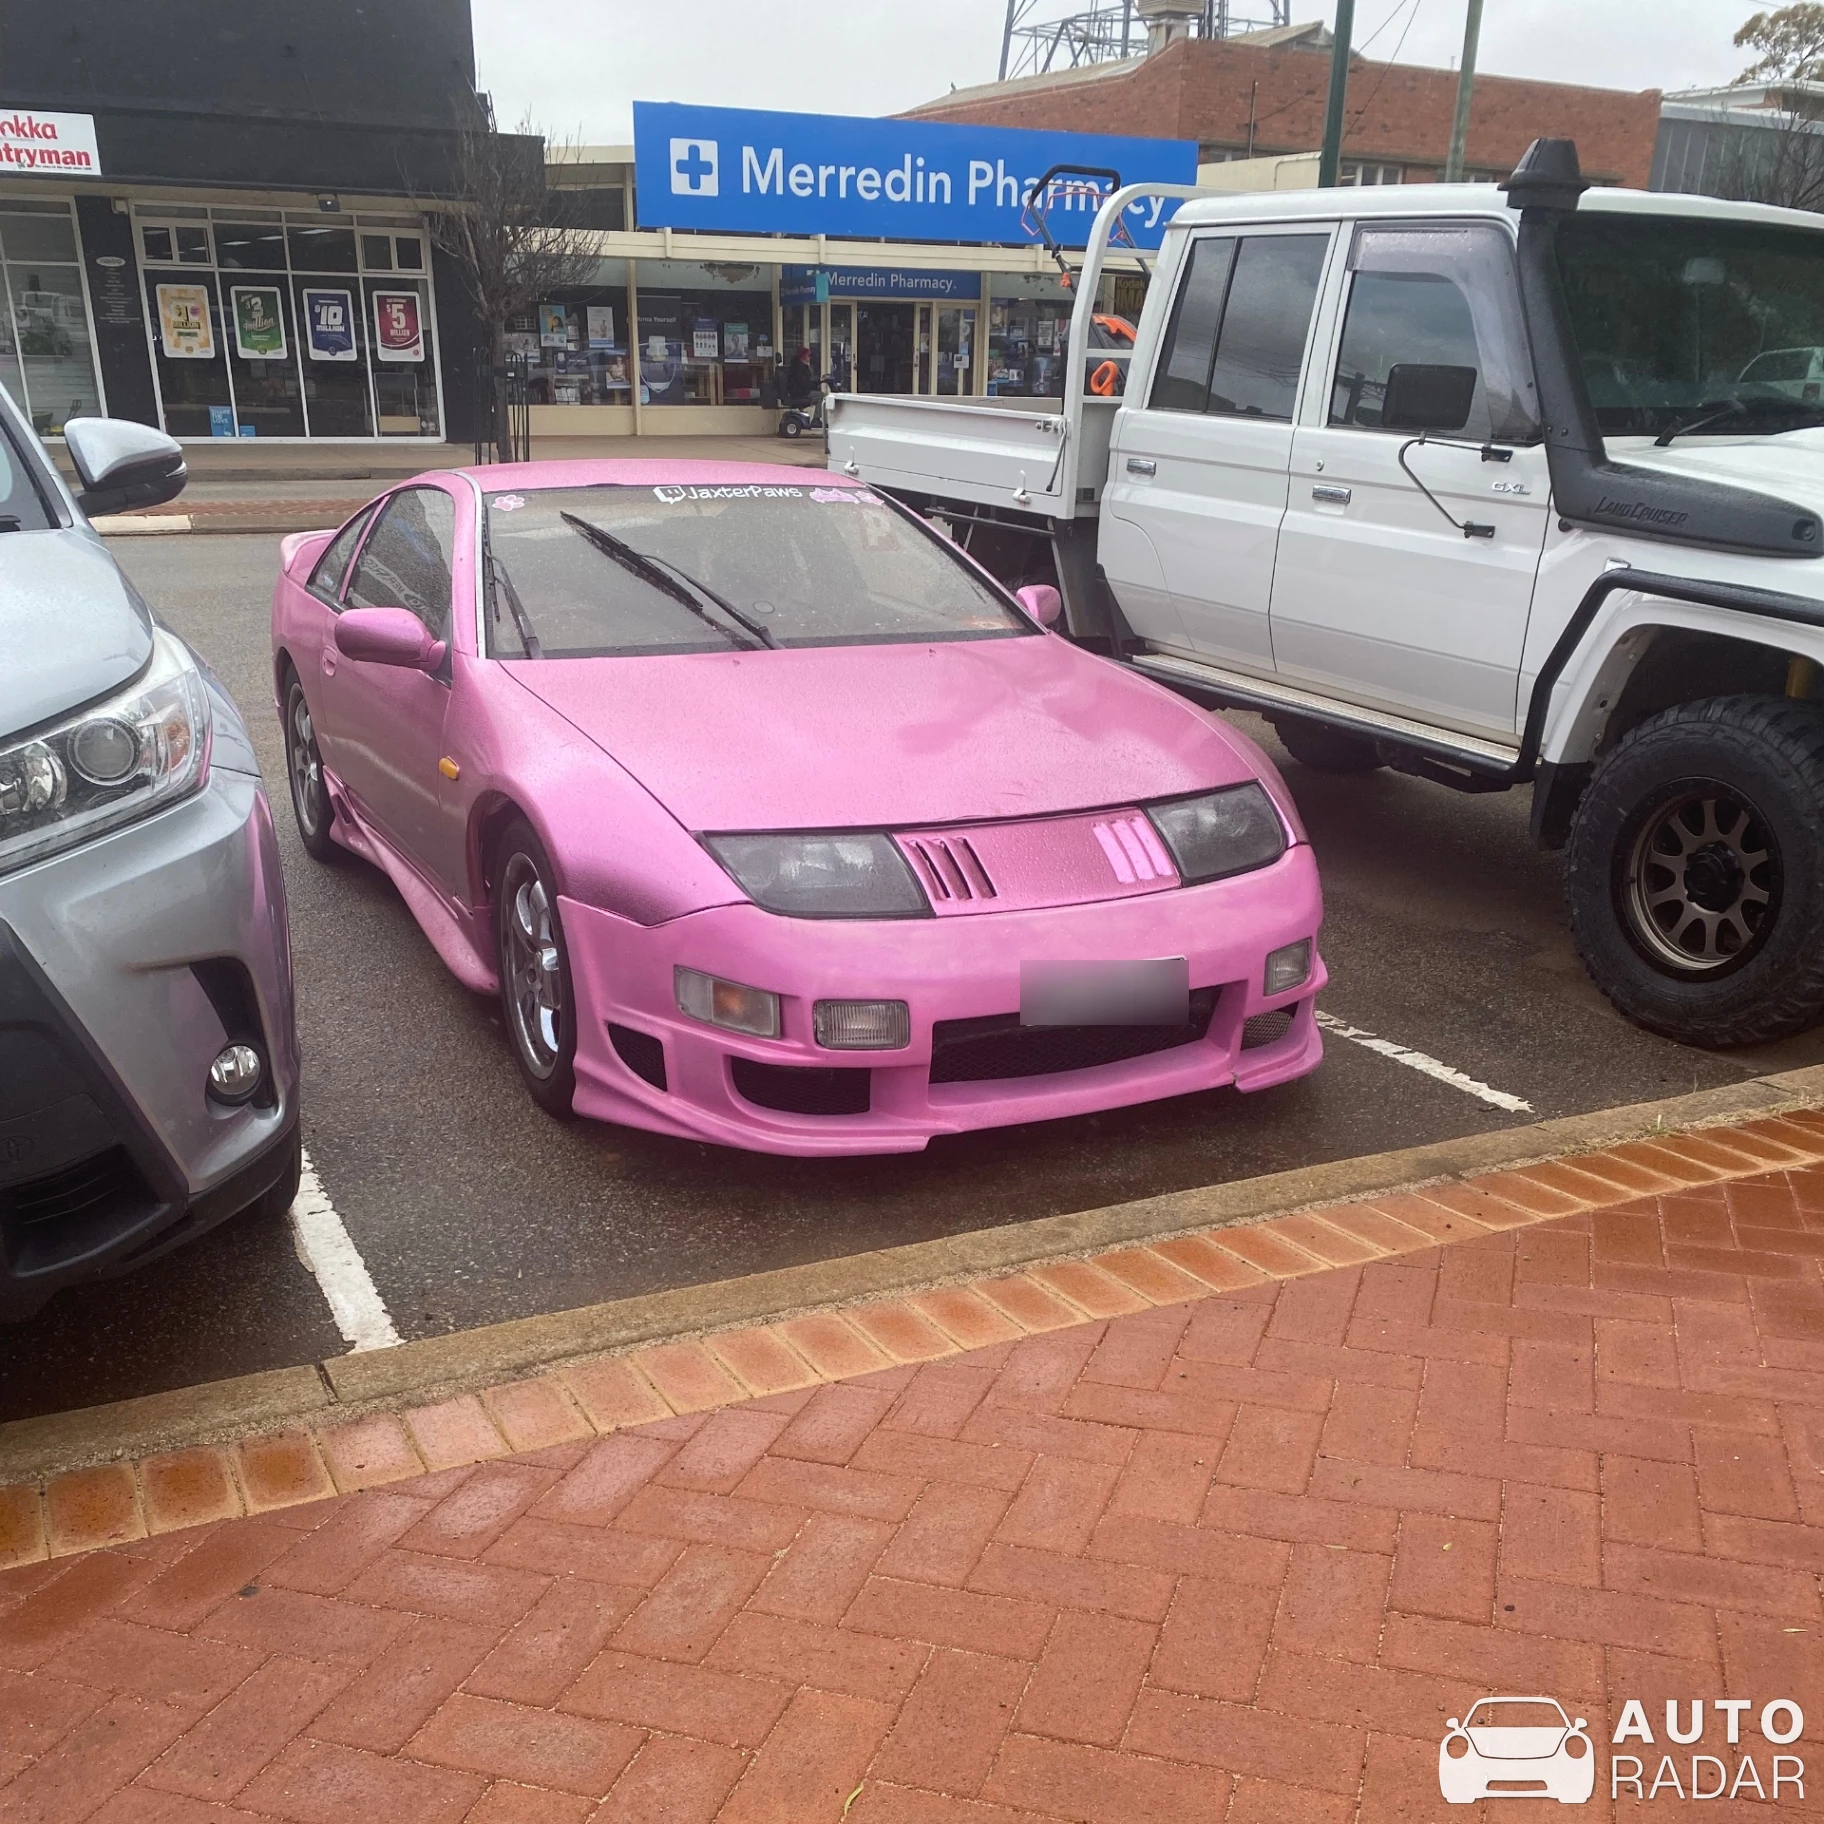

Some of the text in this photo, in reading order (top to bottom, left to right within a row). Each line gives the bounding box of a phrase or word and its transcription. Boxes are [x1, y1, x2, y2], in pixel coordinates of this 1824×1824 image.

[742, 145, 952, 204] Merredin
[826, 271, 886, 287] Merredin
[1117, 278, 1145, 289] Kodak
[390, 329, 410, 337] MILLION
[688, 485, 803, 500] JaxterPaws
[1491, 481, 1531, 495] GXL
